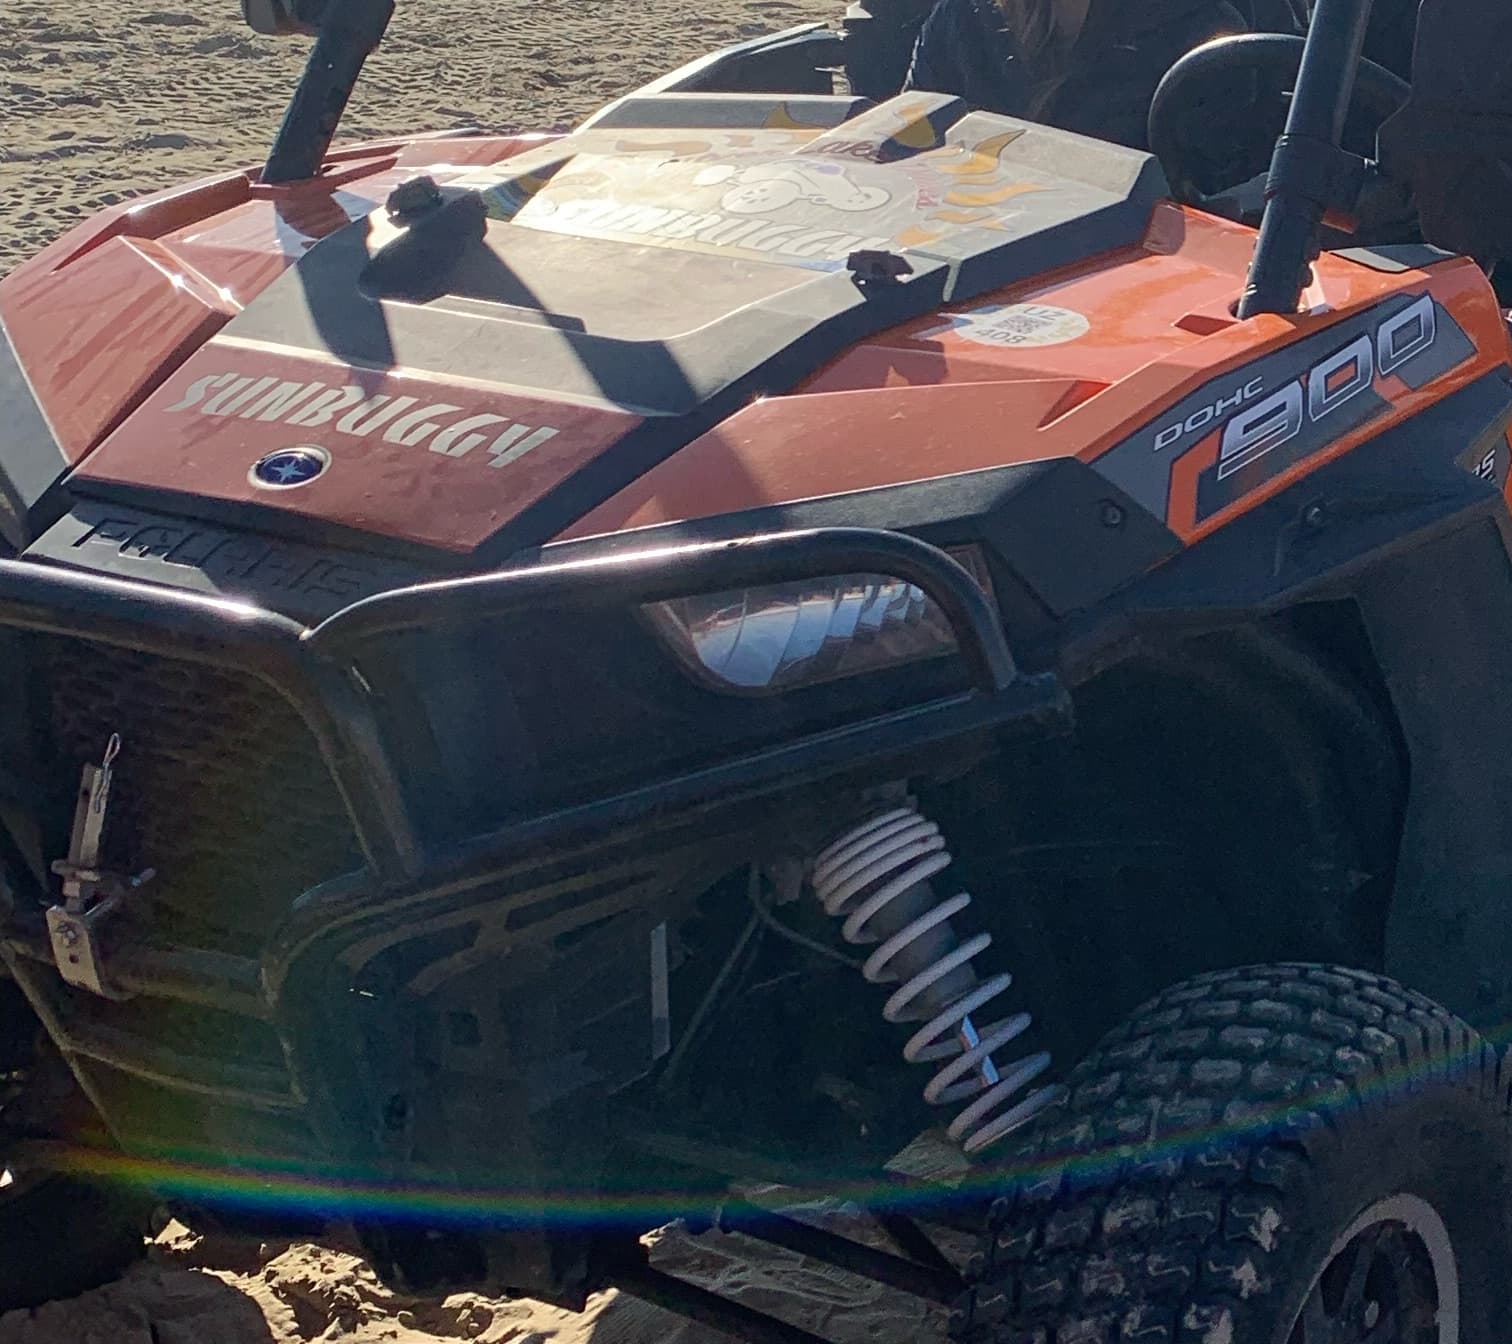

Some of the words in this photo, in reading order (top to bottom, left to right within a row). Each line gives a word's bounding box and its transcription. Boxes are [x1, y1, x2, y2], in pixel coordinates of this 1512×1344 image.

[164, 371, 561, 469] SUNBUGGY
[1153, 375, 1264, 452] DOHC
[1216, 291, 1438, 482] 900
